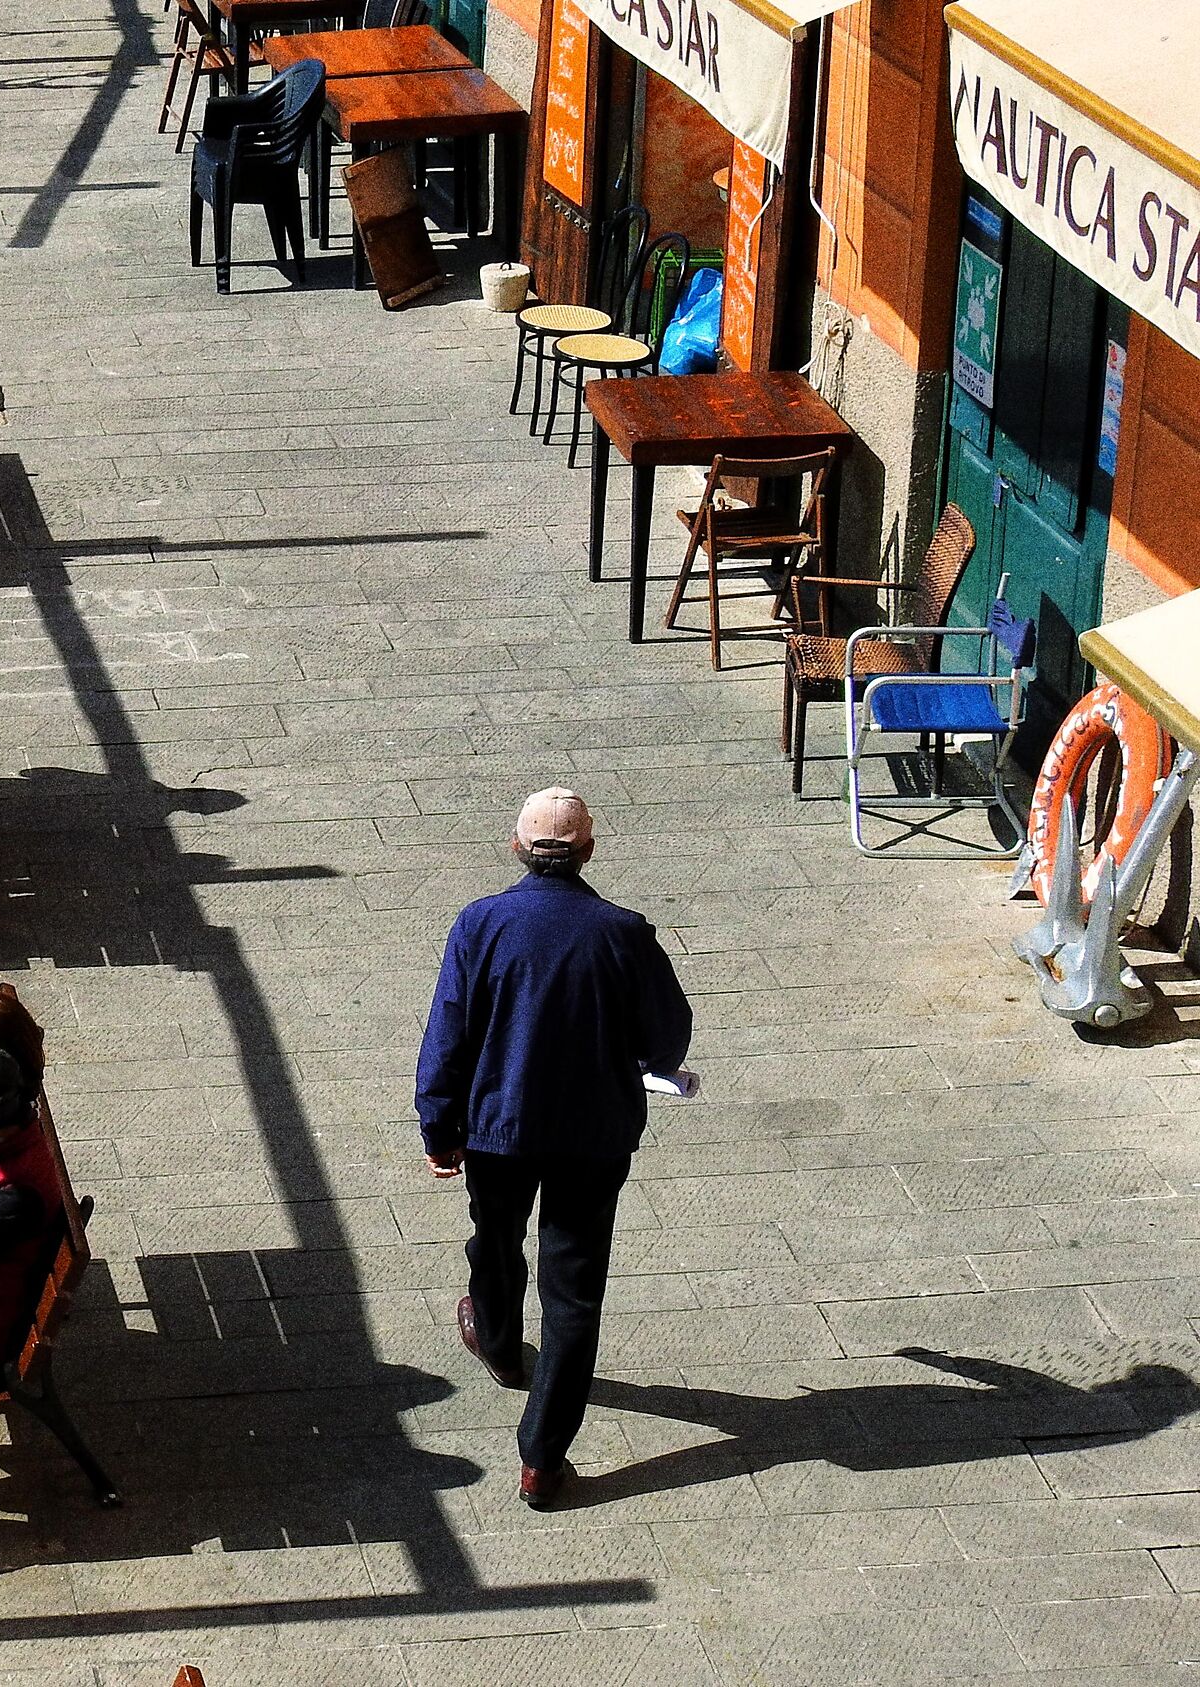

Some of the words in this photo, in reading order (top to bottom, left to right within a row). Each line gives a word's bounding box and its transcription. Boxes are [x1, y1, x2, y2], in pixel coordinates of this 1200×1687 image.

[657, 0, 720, 93] STAR
[953, 62, 1117, 263] NAUTICA
[958, 355, 978, 377] PUNTO
[978, 371, 986, 385] DI
[958, 369, 984, 398] RITROVO
